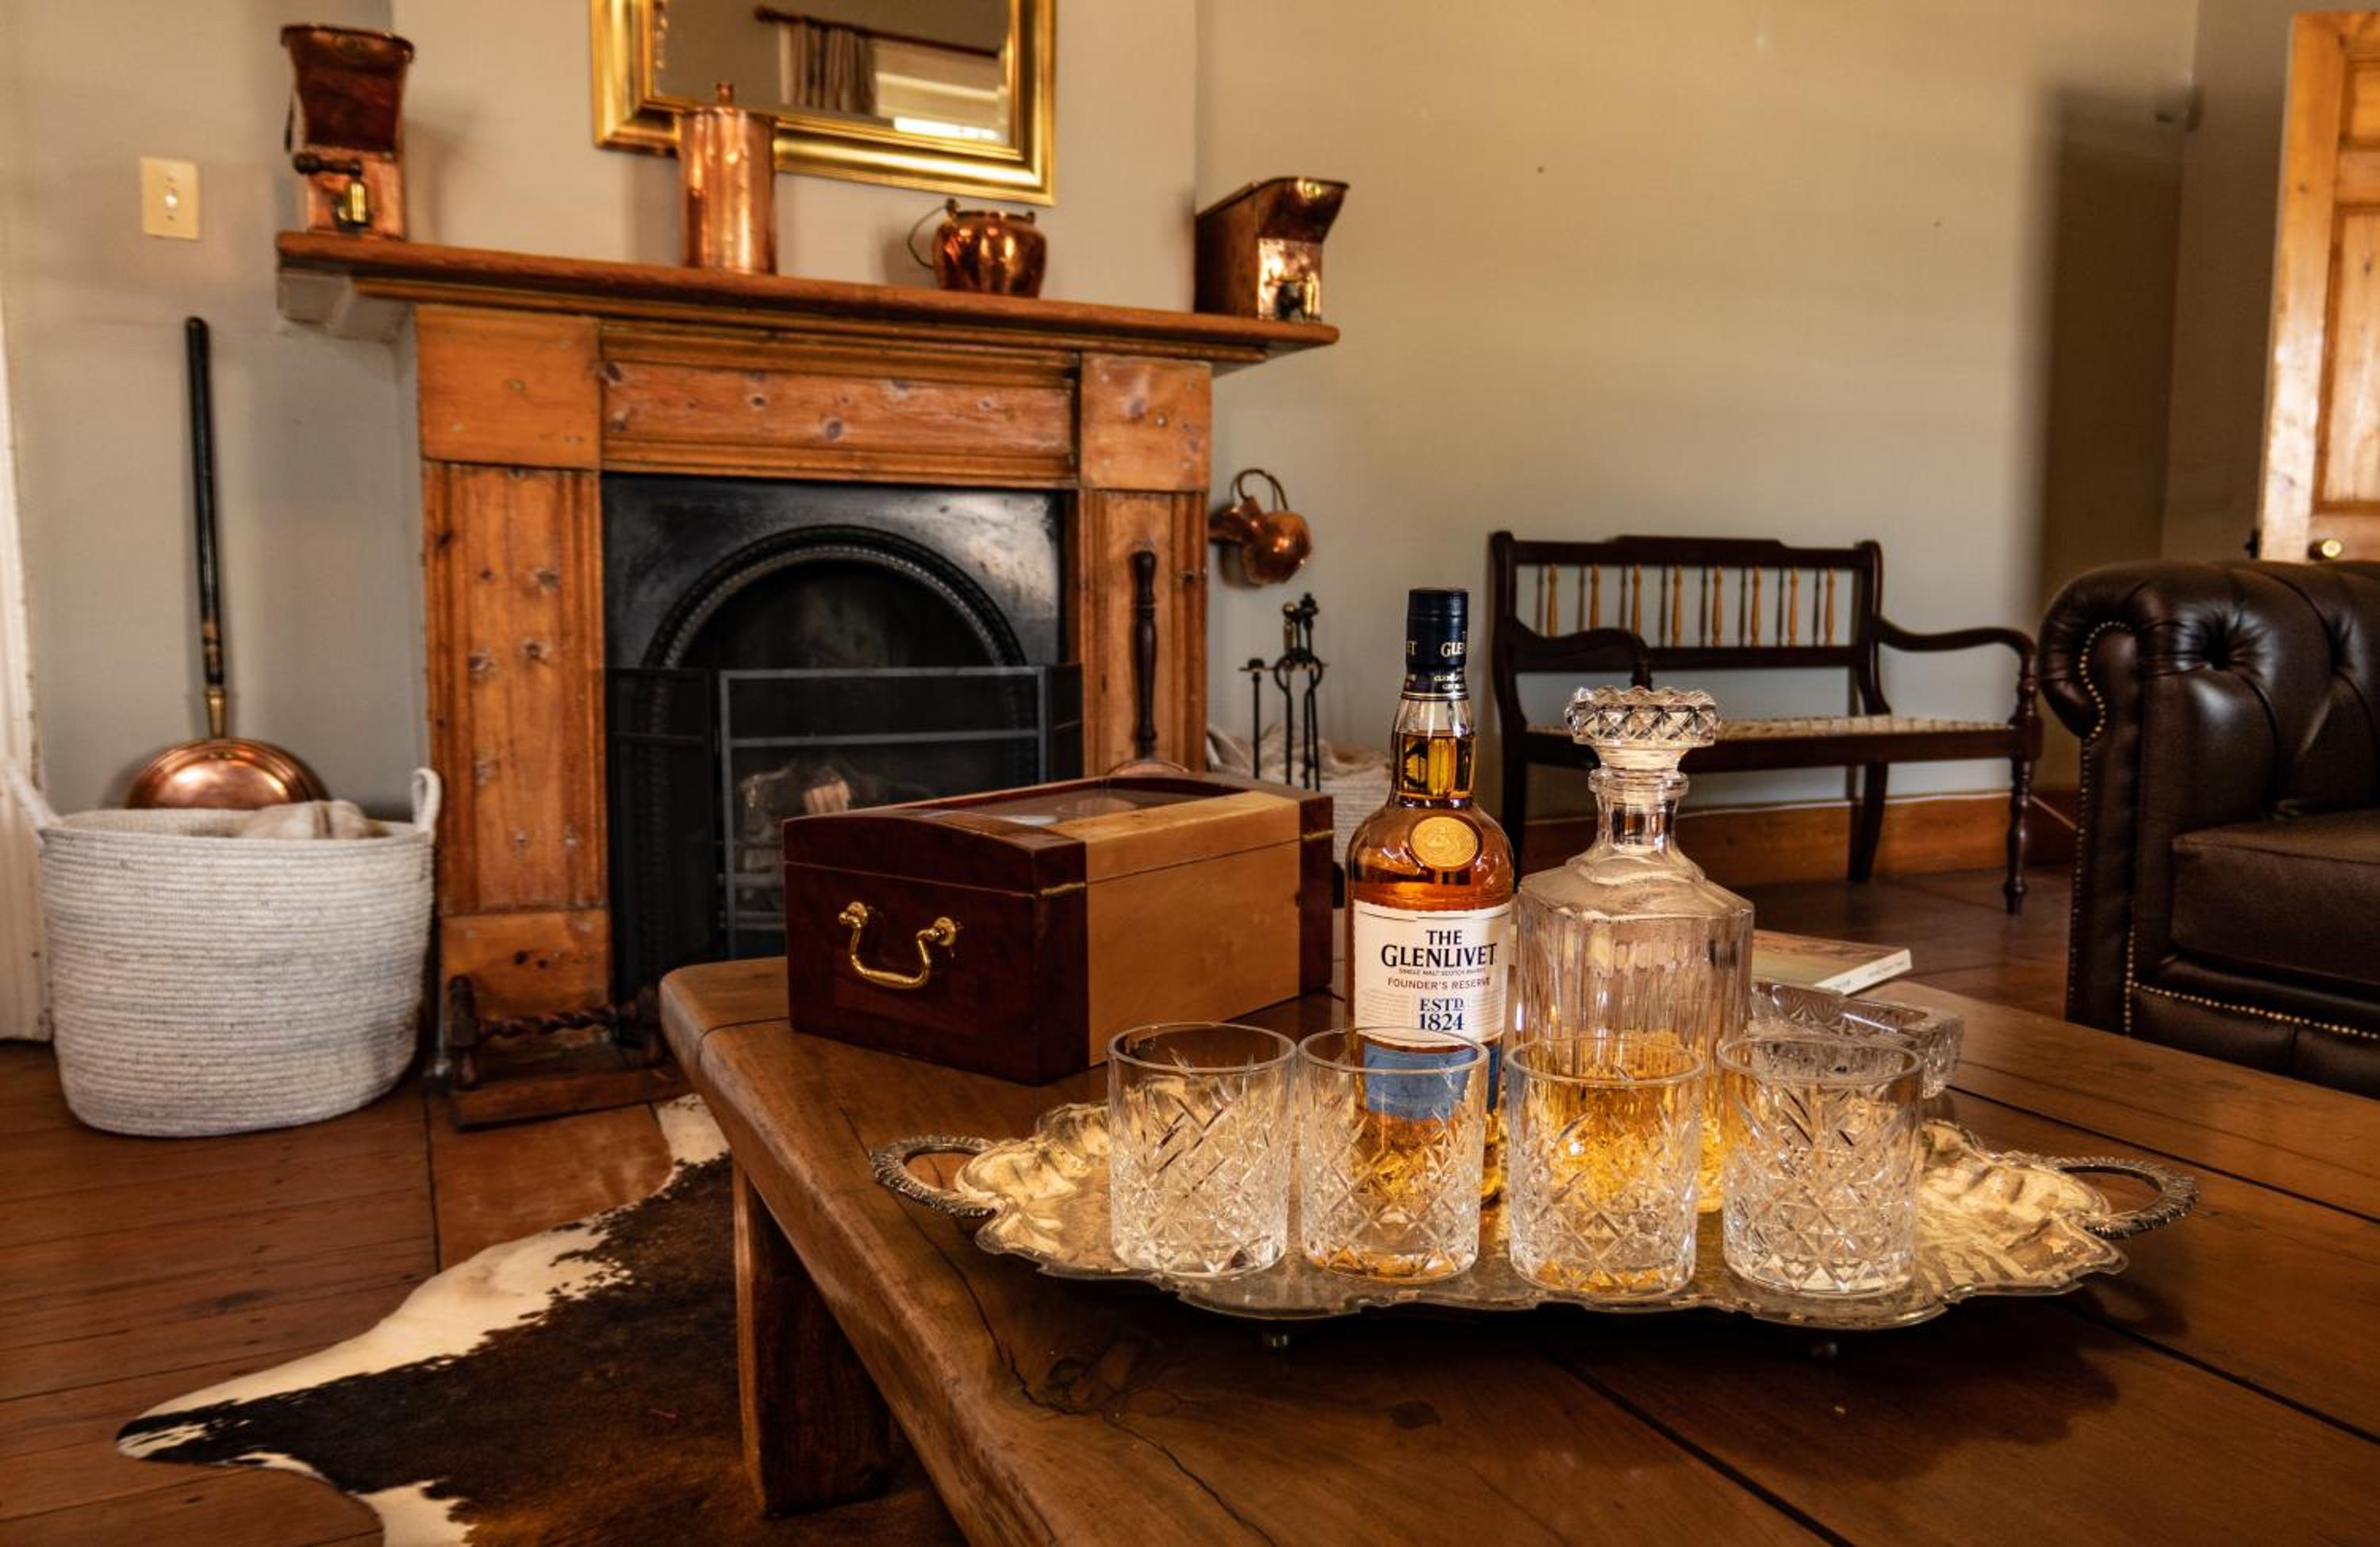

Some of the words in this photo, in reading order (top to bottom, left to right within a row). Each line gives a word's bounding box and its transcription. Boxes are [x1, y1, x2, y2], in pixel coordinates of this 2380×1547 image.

[1426, 929, 1462, 945] THE
[1381, 942, 1497, 968] GLENLIVET
[1388, 977, 1448, 991] FOUNDER'S
[1451, 977, 1491, 989] RESERVE
[1419, 1012, 1465, 1031] 1824
